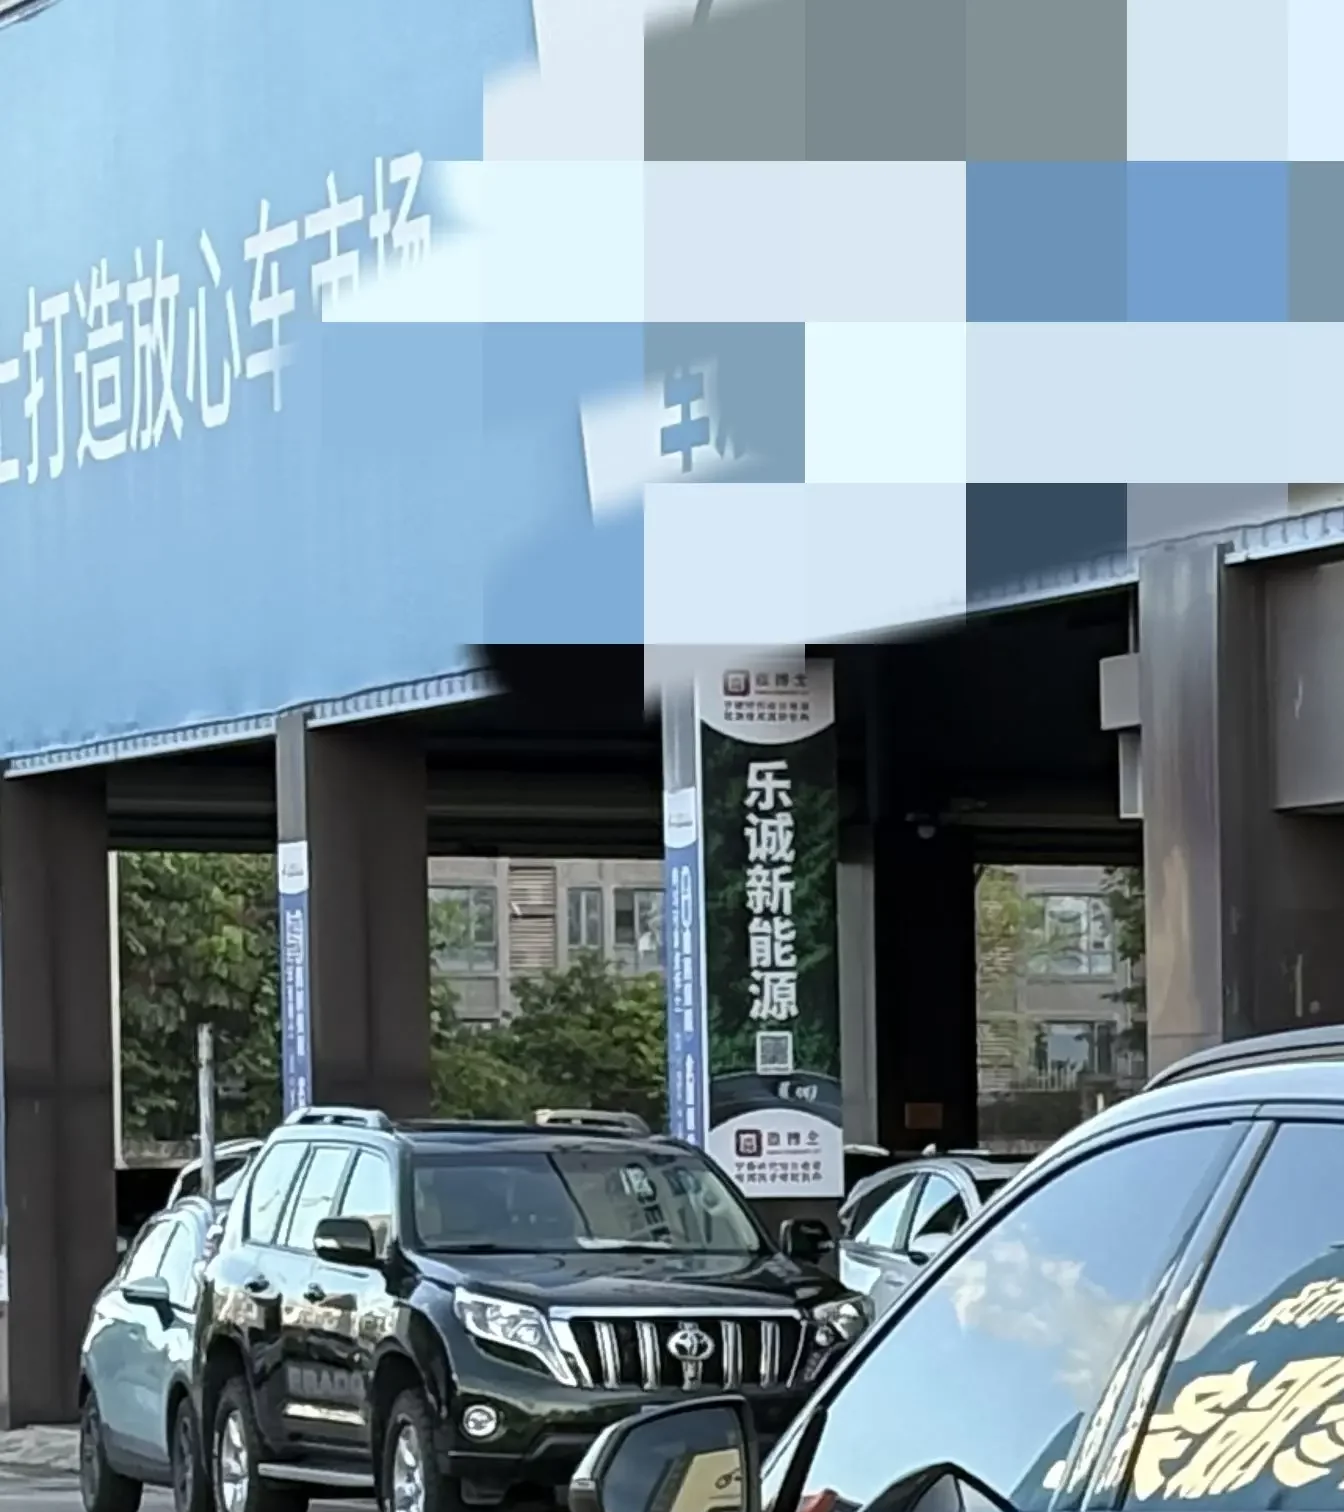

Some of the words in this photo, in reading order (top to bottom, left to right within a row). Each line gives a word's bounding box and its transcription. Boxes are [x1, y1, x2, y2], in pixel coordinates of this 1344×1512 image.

[744, 760, 799, 1020] 乐诚新能源
